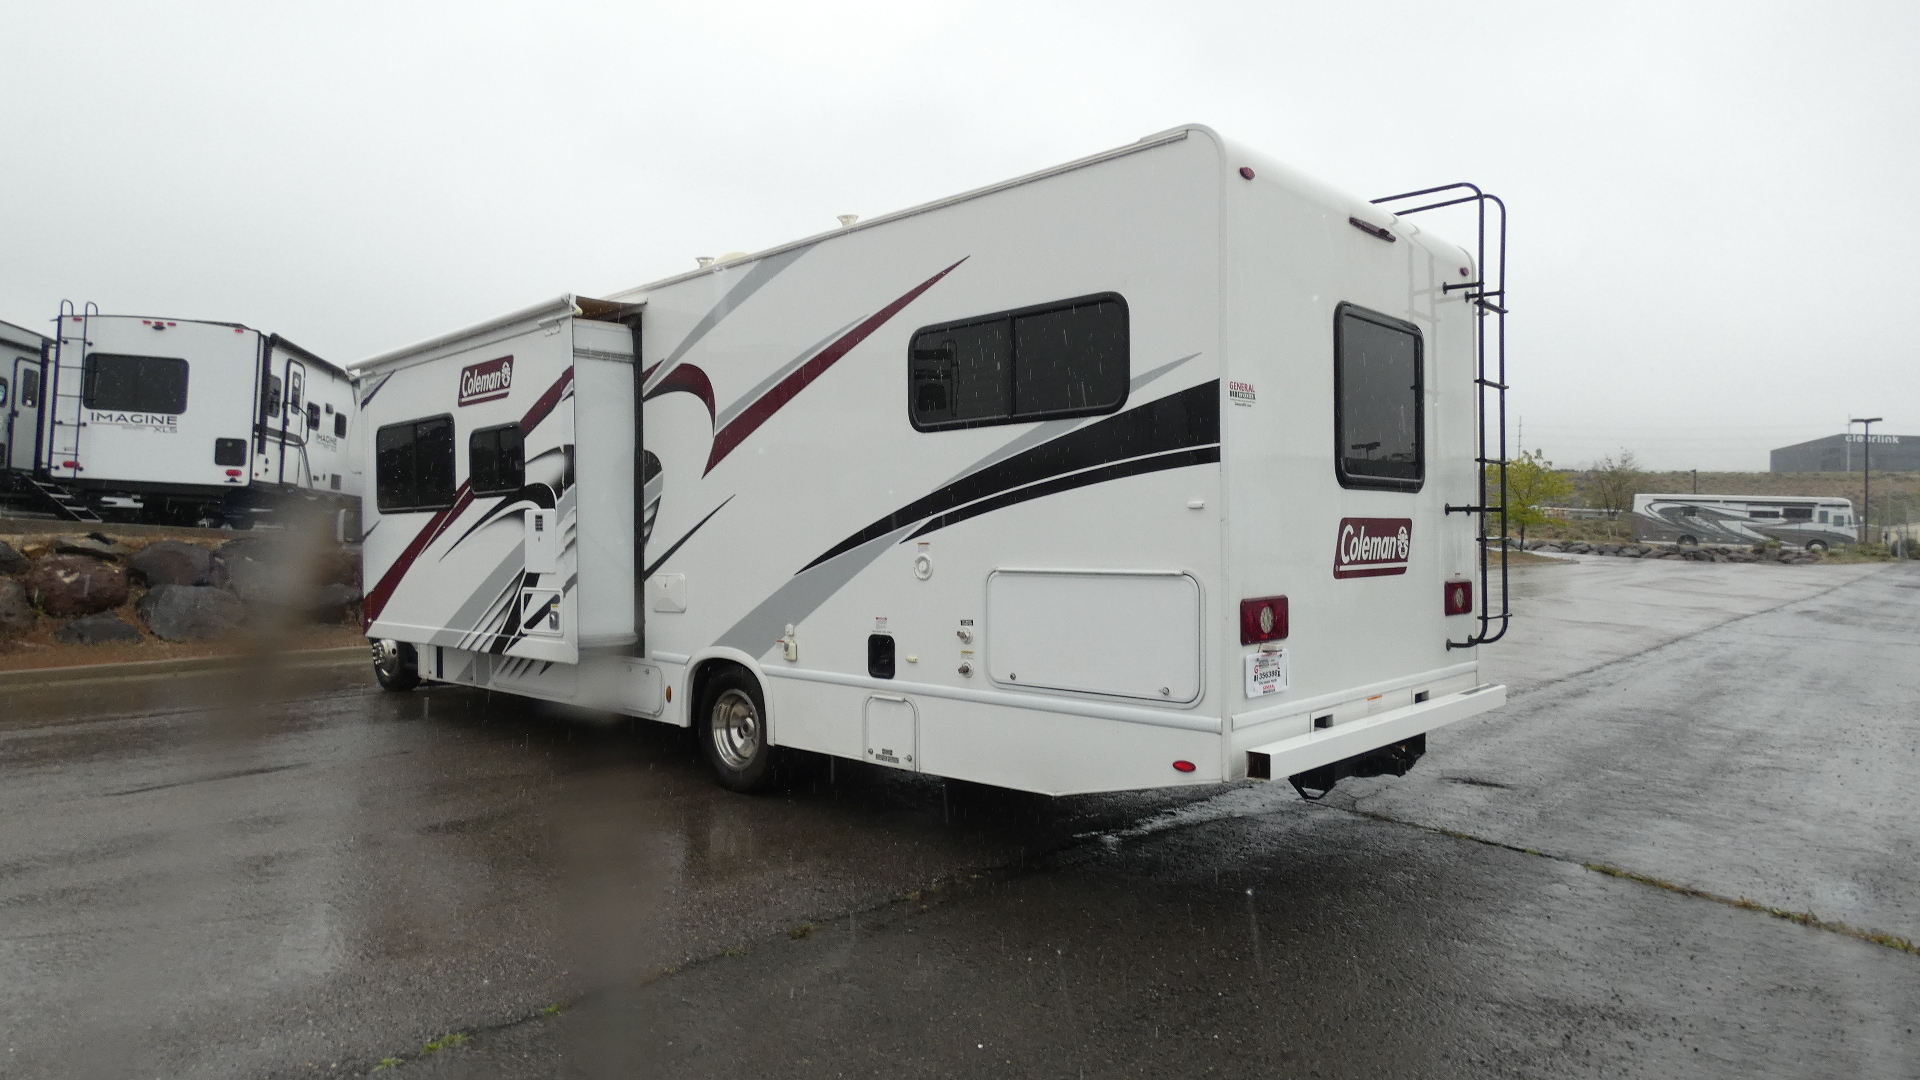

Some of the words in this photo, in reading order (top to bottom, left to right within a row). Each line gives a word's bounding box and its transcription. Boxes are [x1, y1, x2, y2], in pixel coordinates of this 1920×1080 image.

[462, 368, 501, 397] Coleman
[1229, 381, 1255, 393] GENERAL
[91, 412, 178, 425] IMAGINE
[1341, 524, 1397, 564] Coleman
